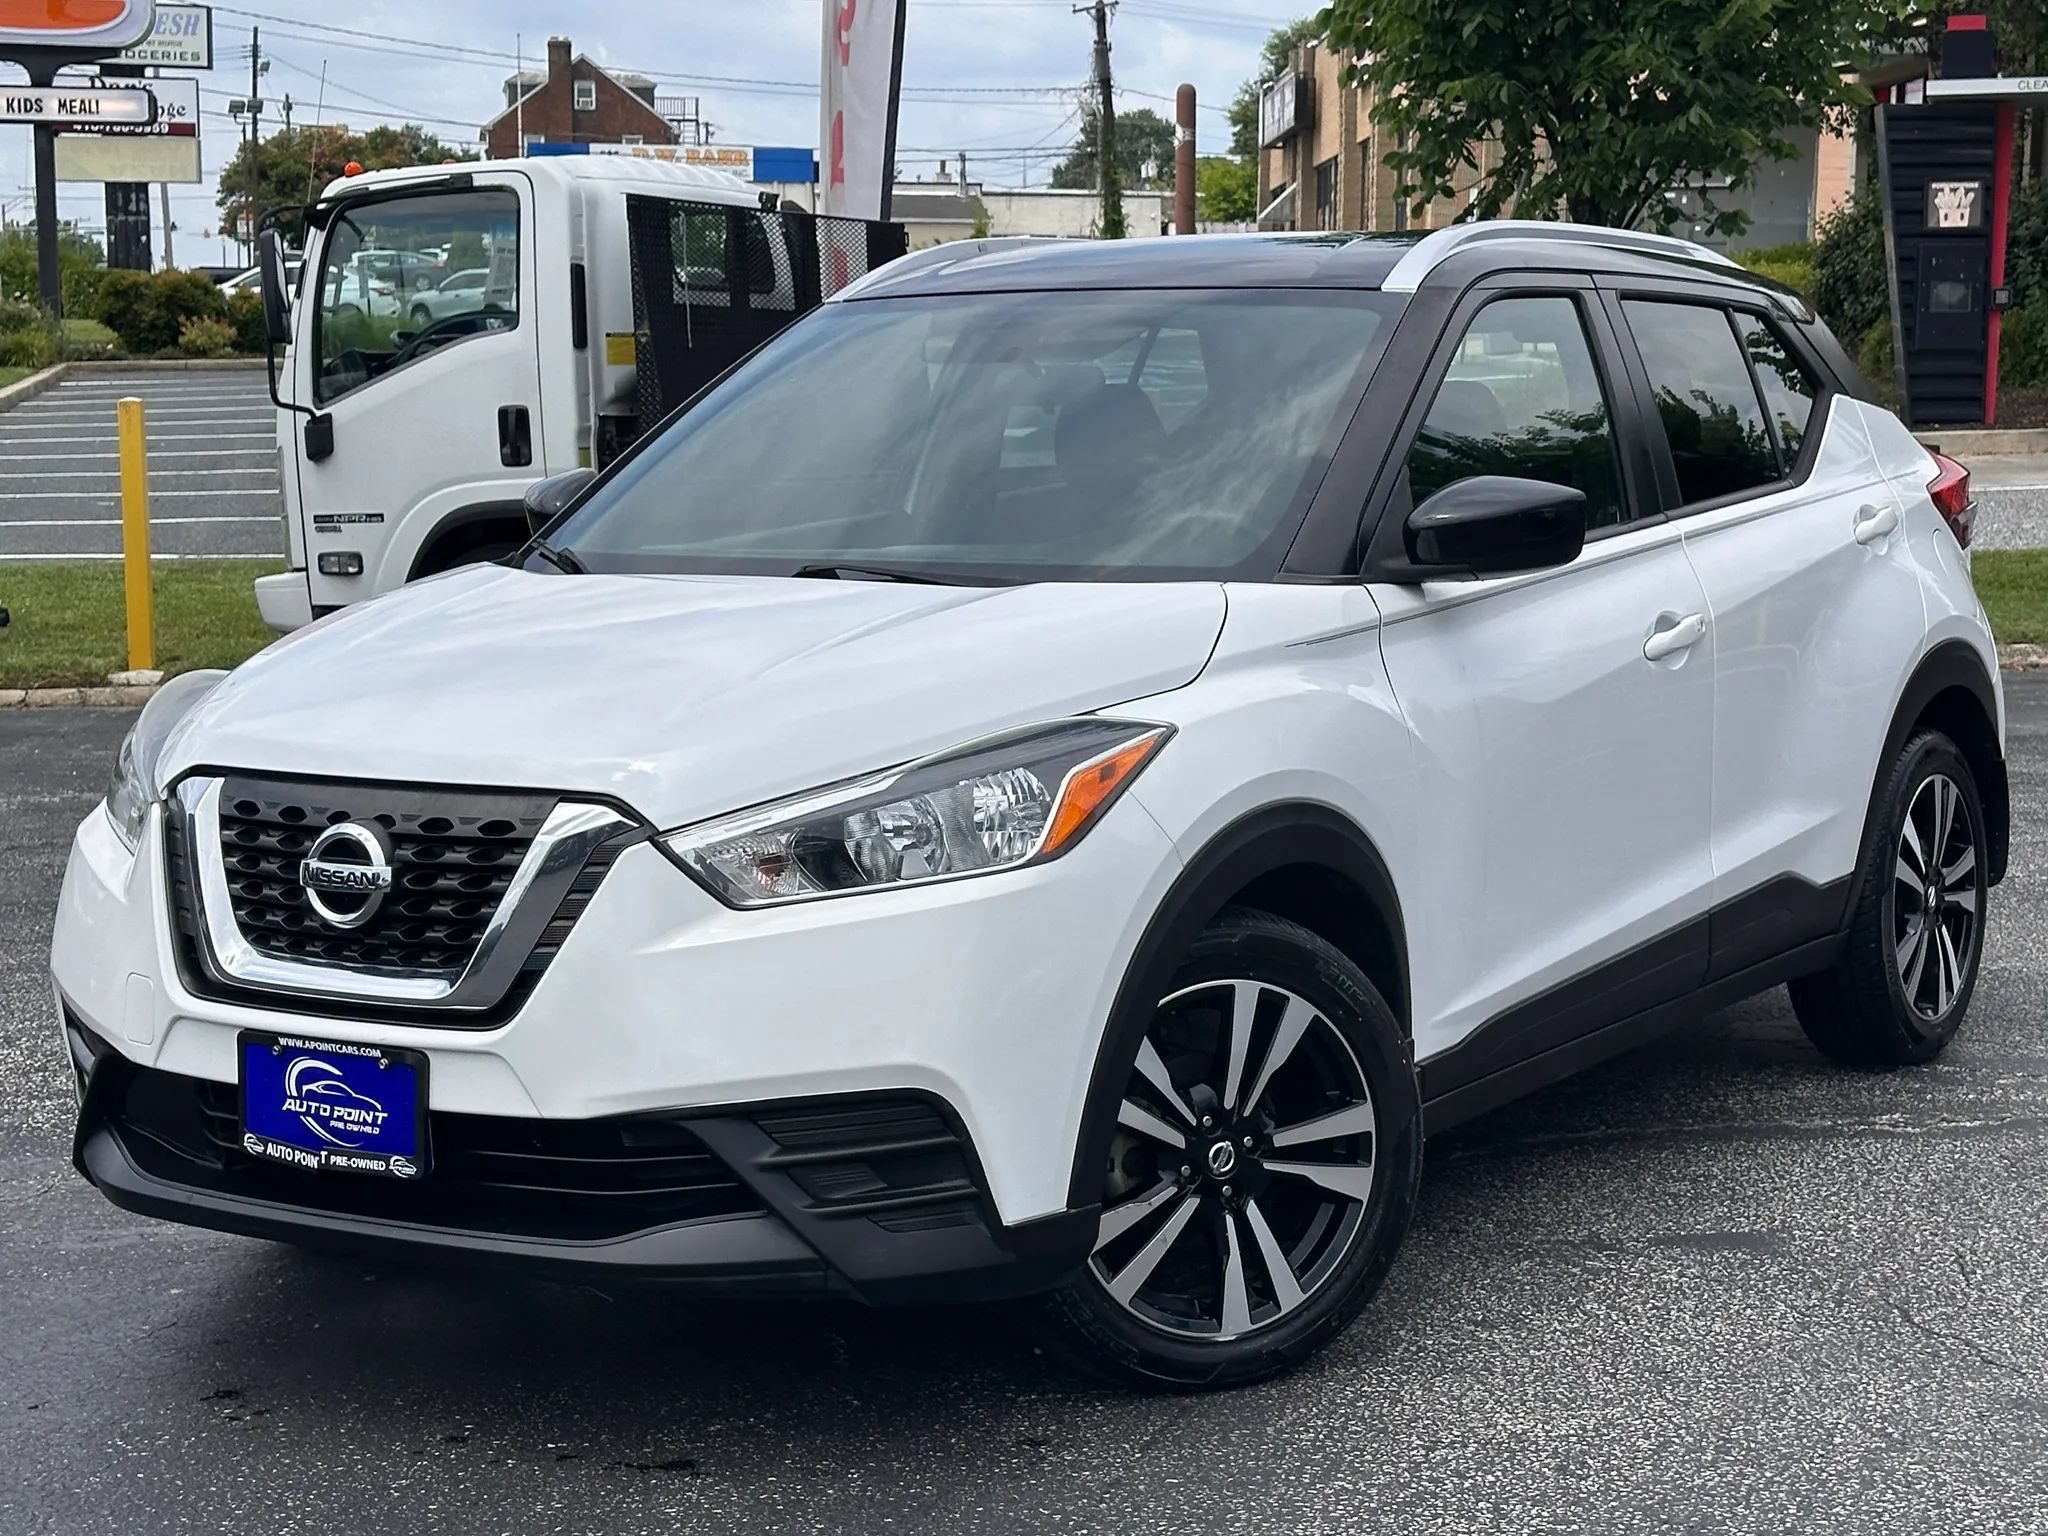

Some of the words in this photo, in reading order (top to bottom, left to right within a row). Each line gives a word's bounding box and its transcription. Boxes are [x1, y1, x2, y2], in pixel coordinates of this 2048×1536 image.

[120, 49, 201, 62] OCERIES
[6, 97, 43, 114] KIDS
[57, 98, 100, 115] MEAL!
[303, 861, 377, 889] NISSAN
[278, 1036, 382, 1058] WWW.APOINTCARS.COM
[282, 1098, 331, 1117] AUTO
[333, 1105, 388, 1125] POINT
[346, 1123, 380, 1135] OWNED
[266, 1142, 294, 1161] AUTO
[294, 1150, 328, 1169] POINT
[329, 1154, 386, 1171] PRE-OWNED
